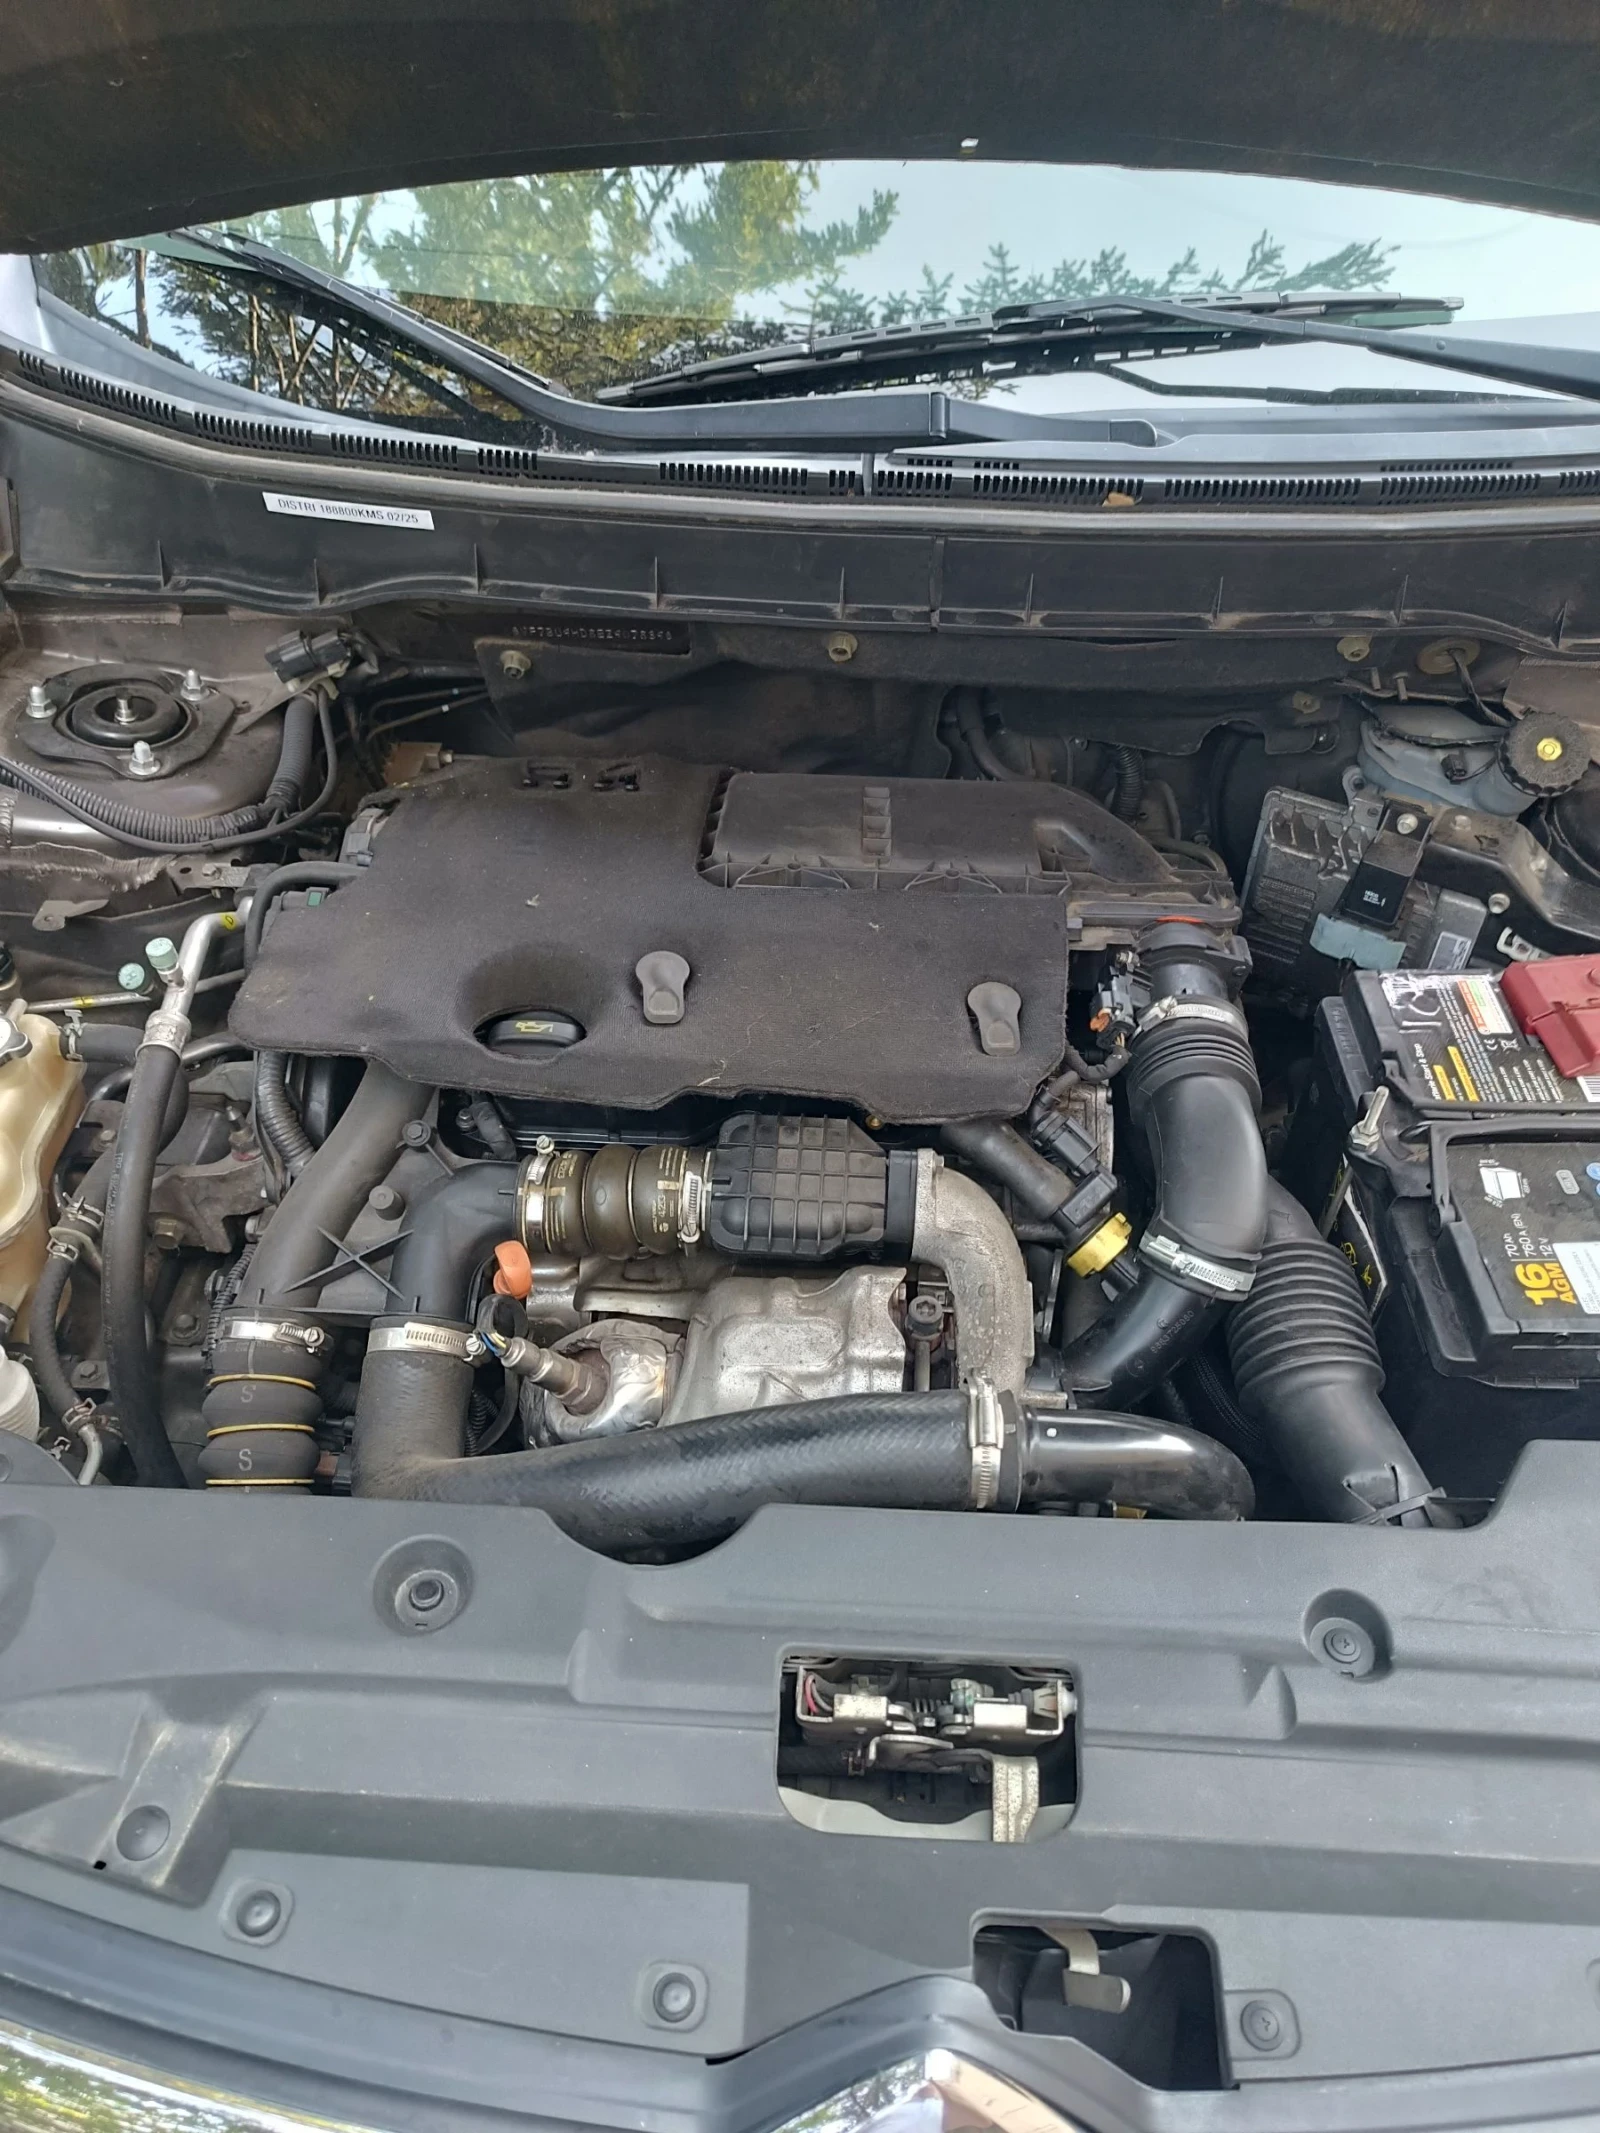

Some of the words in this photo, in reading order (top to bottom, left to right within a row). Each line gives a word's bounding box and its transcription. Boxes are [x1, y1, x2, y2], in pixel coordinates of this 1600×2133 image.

[277, 498, 316, 513] DISTRI
[387, 511, 419, 524] 02/25
[1413, 1043, 1424, 1057] Stop
[1420, 1064, 1432, 1079] Start
[1515, 1263, 1559, 1306] 16
[1543, 1262, 1577, 1305] AGM
[240, 1384, 257, 1403] S
[238, 1448, 253, 1472] S
